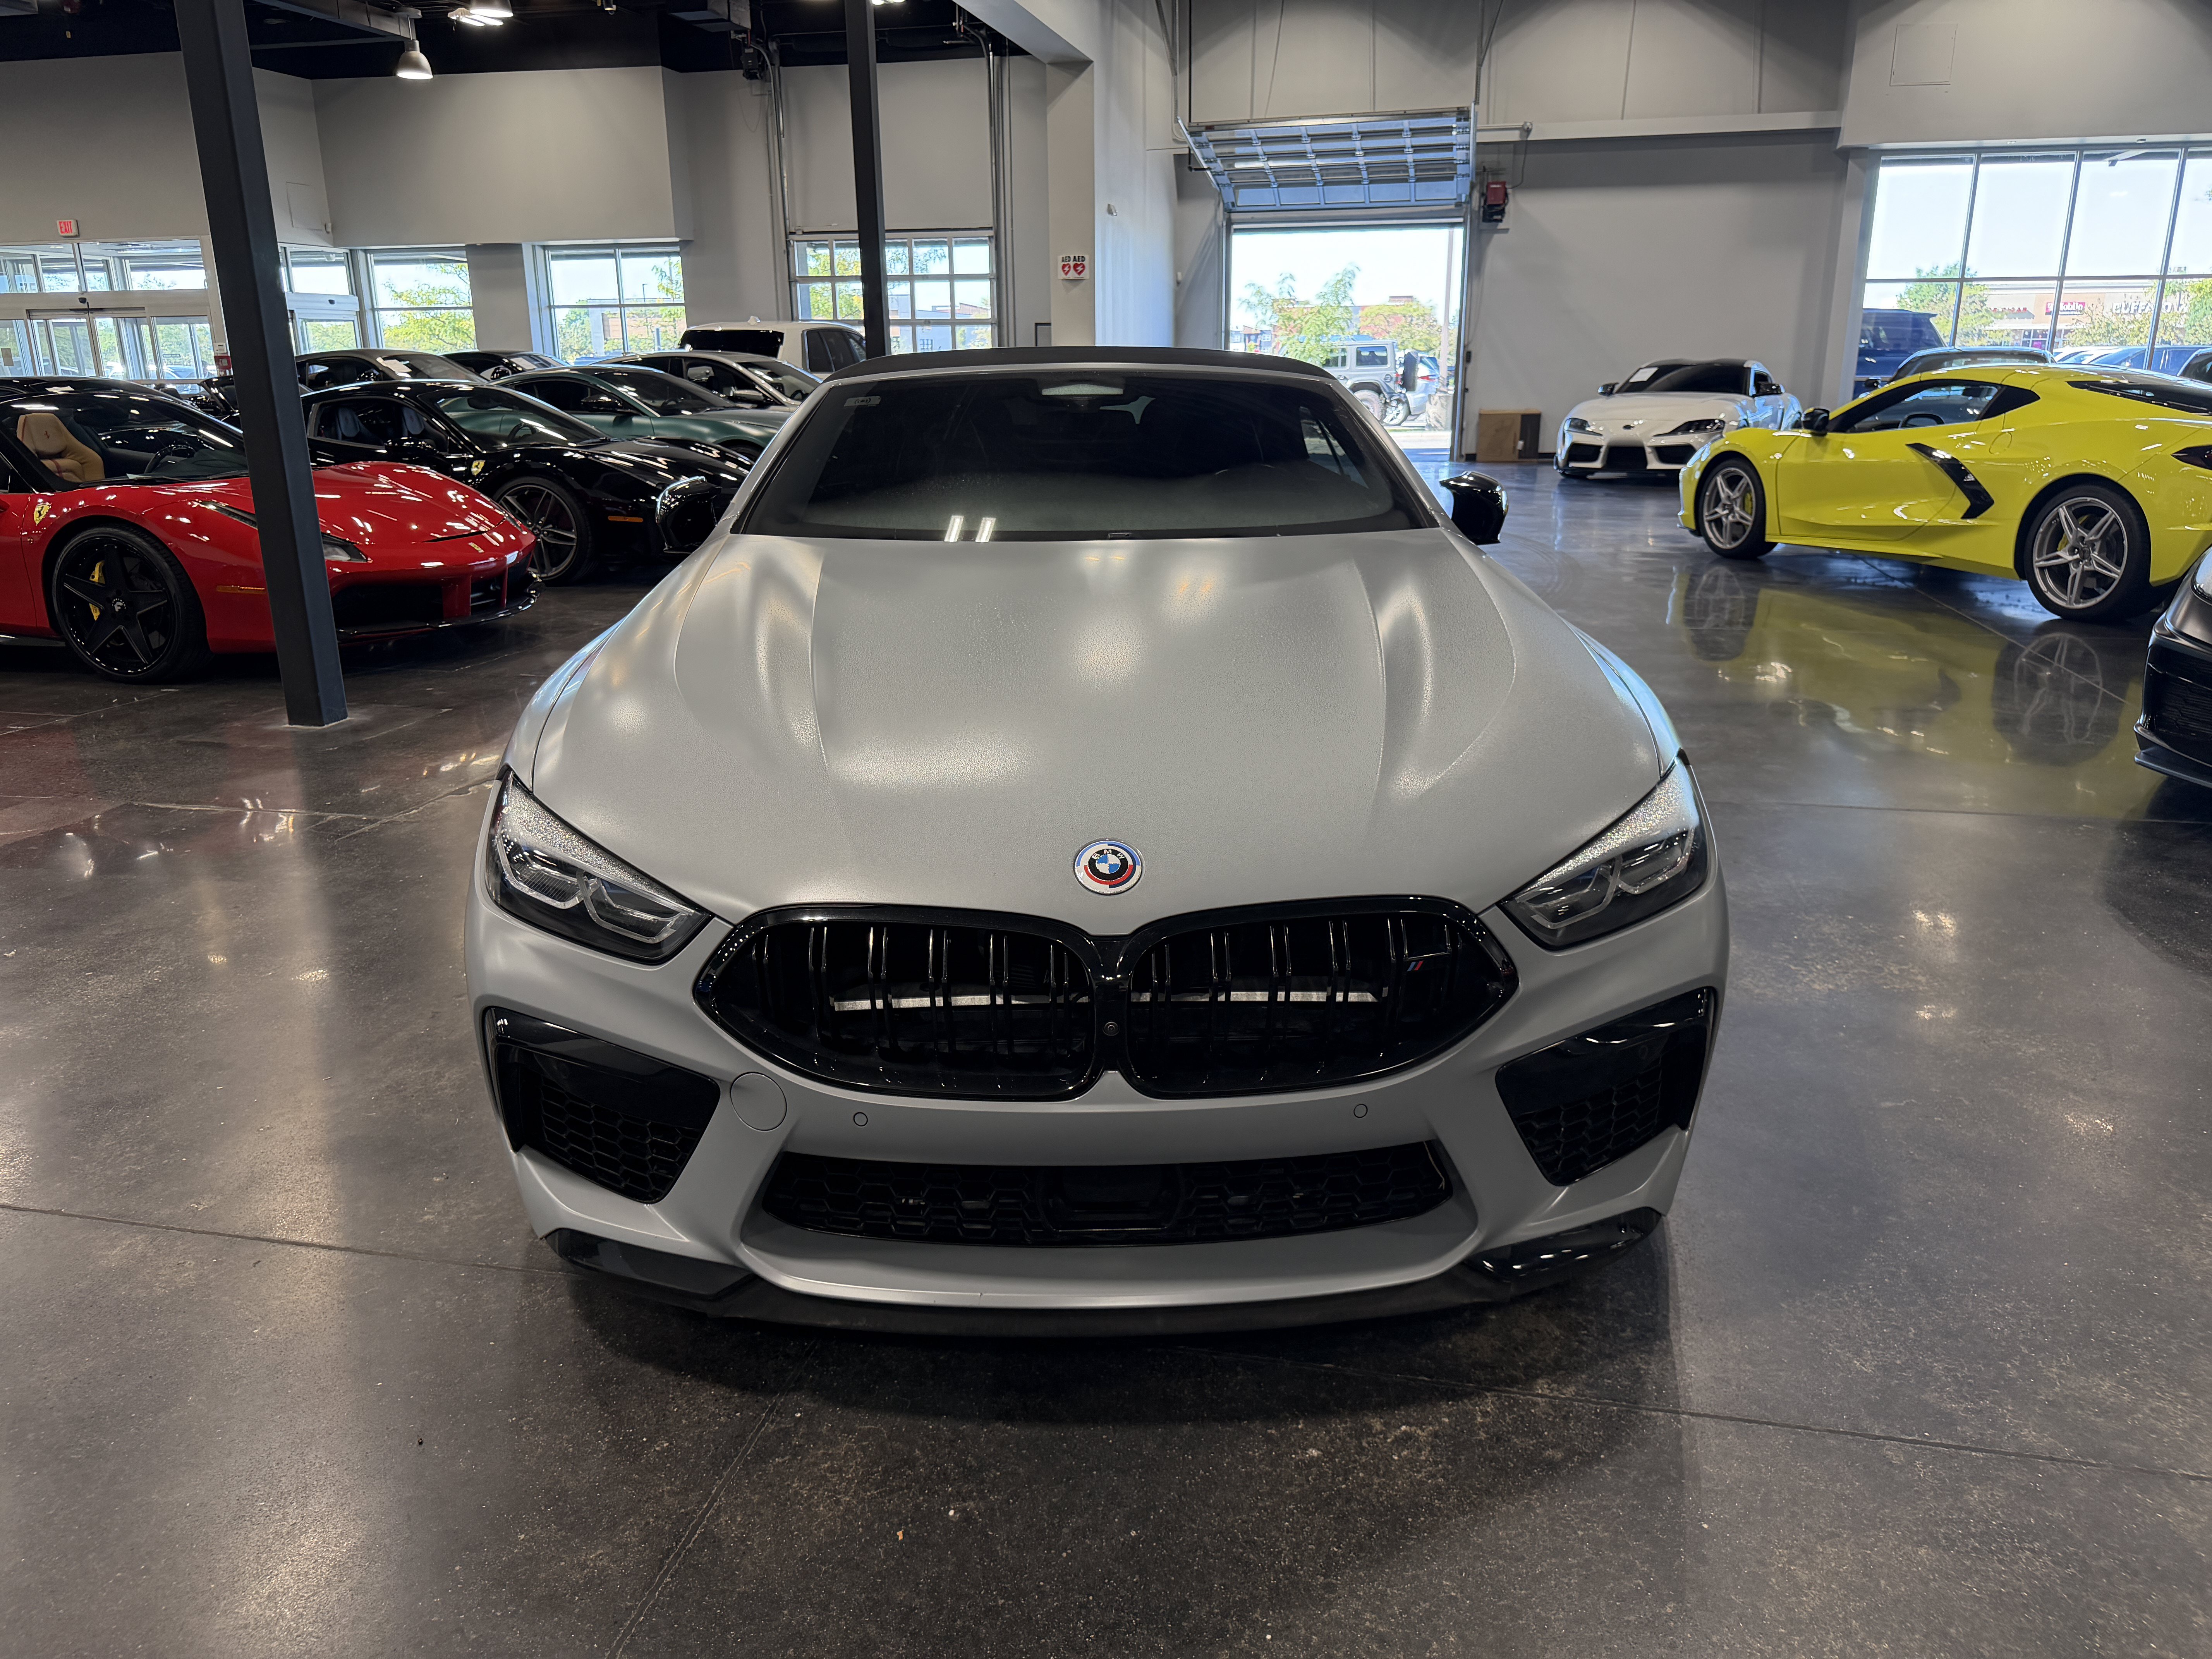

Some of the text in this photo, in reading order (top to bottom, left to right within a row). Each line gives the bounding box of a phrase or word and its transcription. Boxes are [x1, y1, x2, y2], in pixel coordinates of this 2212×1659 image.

[59, 221, 72, 234] EXIT
[2047, 302, 2083, 311] Tobile
[2112, 302, 2172, 313] BUFFAO
[1092, 849, 1125, 860] BMW
